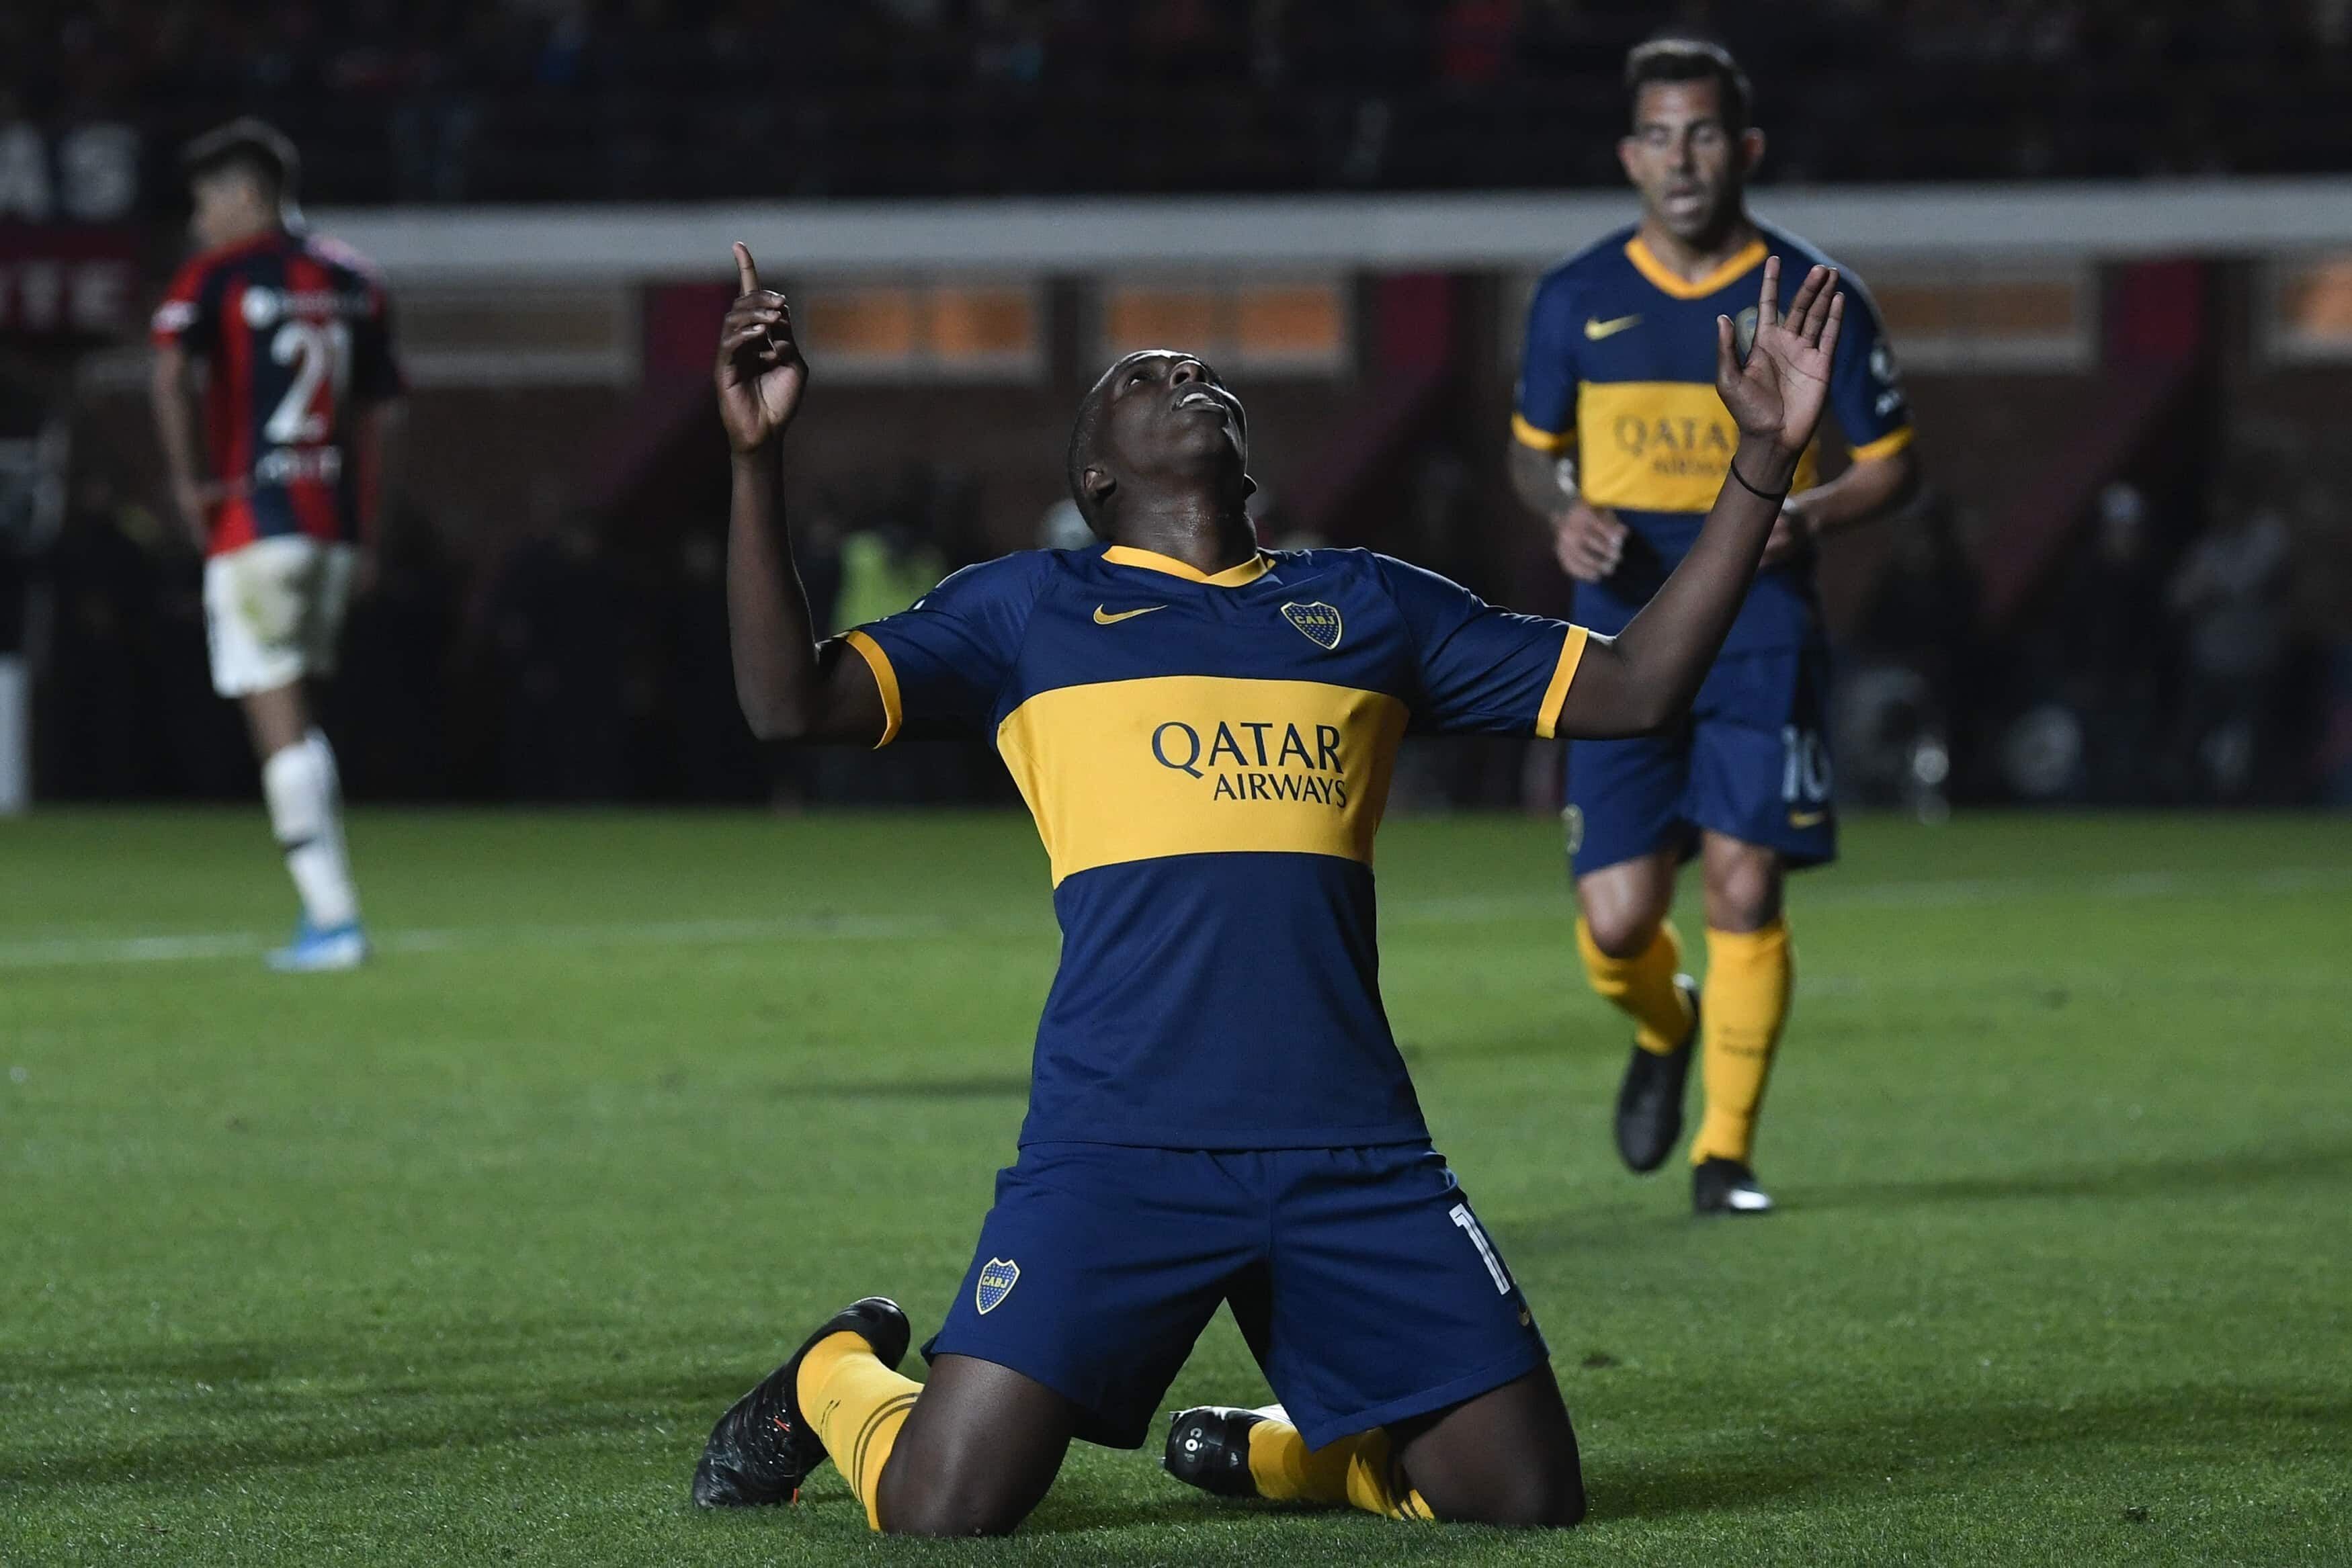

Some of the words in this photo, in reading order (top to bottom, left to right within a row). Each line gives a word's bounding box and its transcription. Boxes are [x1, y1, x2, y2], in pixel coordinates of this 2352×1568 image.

[264, 320, 353, 445] 21
[1152, 721, 1343, 779] QATAR
[1781, 724, 1834, 803] 10
[1214, 773, 1347, 808] AIRWAYS
[982, 1275, 1010, 1289] CABJ
